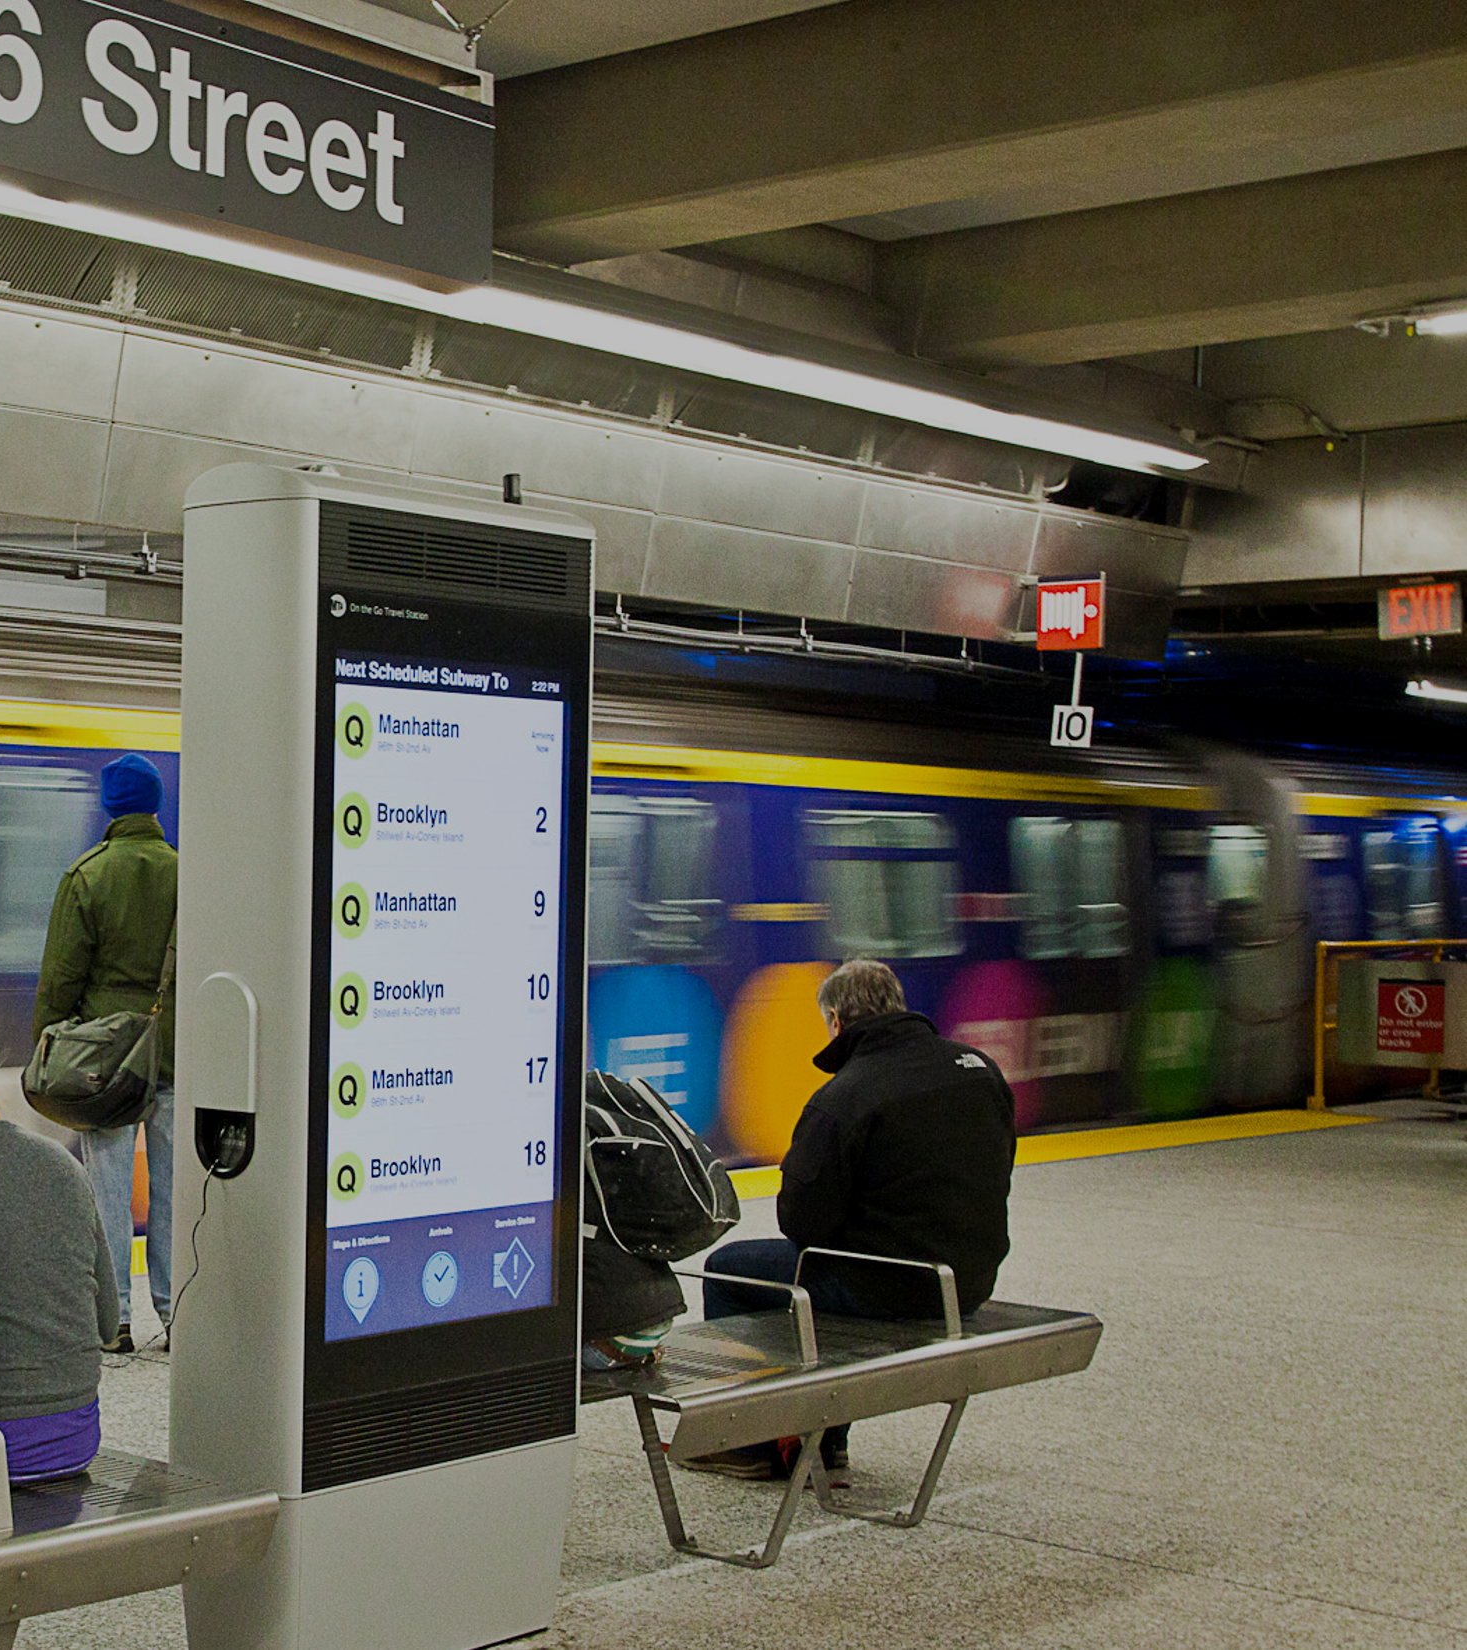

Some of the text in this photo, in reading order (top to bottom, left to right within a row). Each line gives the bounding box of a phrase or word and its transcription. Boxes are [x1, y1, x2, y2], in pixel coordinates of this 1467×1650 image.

[81, 19, 405, 226] Street
[349, 602, 360, 613] On
[361, 604, 373, 614] the
[373, 605, 384, 616] Go
[384, 606, 405, 618] Travel
[405, 609, 429, 620] Station
[1388, 583, 1456, 634] EXIT
[335, 657, 509, 692] Next Scheduled Subway To
[548, 682, 560, 693] PM
[344, 713, 459, 748] Q Manhattan
[1056, 711, 1087, 741] 10
[343, 802, 447, 838] Q Brooklyn
[535, 806, 547, 833] 2
[341, 892, 457, 927] Q Manhattan
[534, 890, 546, 917] 9
[340, 979, 444, 1017] Q Brooklyn
[527, 973, 550, 1001] 10
[1379, 1016, 1443, 1029] Do not enter
[1379, 1028, 1421, 1038] or cross
[1379, 1037, 1412, 1048] tracks
[526, 1057, 549, 1084] 17
[338, 1067, 453, 1107] Q Manhattan
[524, 1140, 546, 1166] 18
[337, 1154, 441, 1193] Q Brooklyn
[357, 1235, 391, 1247] Directions
[429, 1226, 453, 1237] Arrivals
